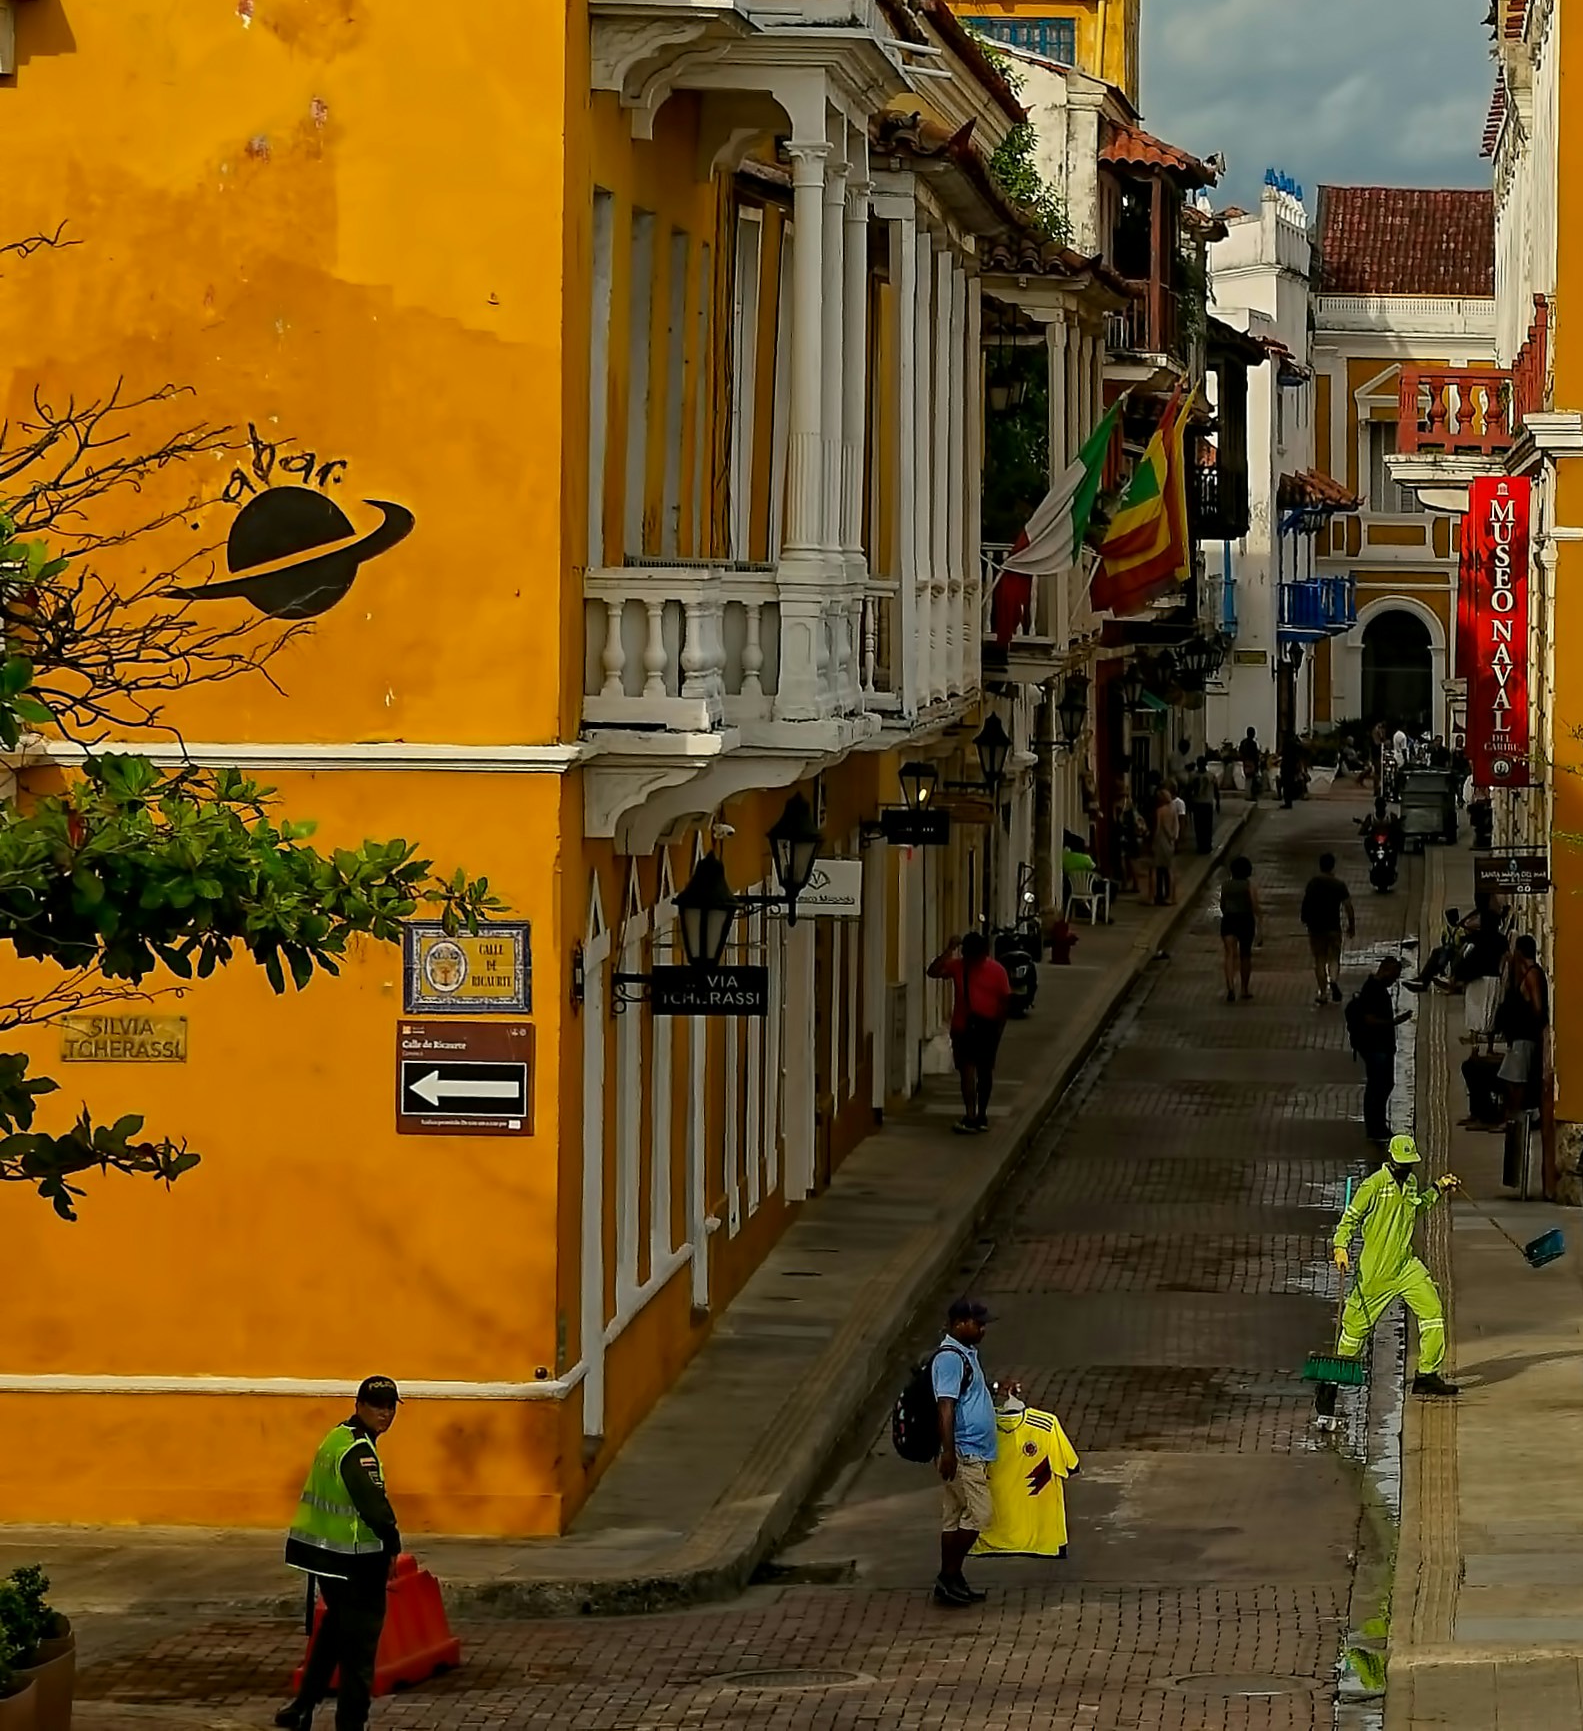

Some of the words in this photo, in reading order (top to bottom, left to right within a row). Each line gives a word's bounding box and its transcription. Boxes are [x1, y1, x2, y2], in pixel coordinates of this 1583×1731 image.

[1489, 499, 1516, 613] MUSEO
[1491, 619, 1513, 732] NAVAL
[1492, 734, 1511, 743] DEL
[1484, 743, 1519, 751] CARIBE
[478, 943, 504, 955] CALLE
[486, 960, 497, 972] DE
[471, 975, 512, 988] RICAURTE
[91, 1018, 154, 1036] SILVIA
[66, 1040, 181, 1059] TCHERASSI
[402, 1039, 421, 1049] Calle
[422, 1039, 432, 1049] de
